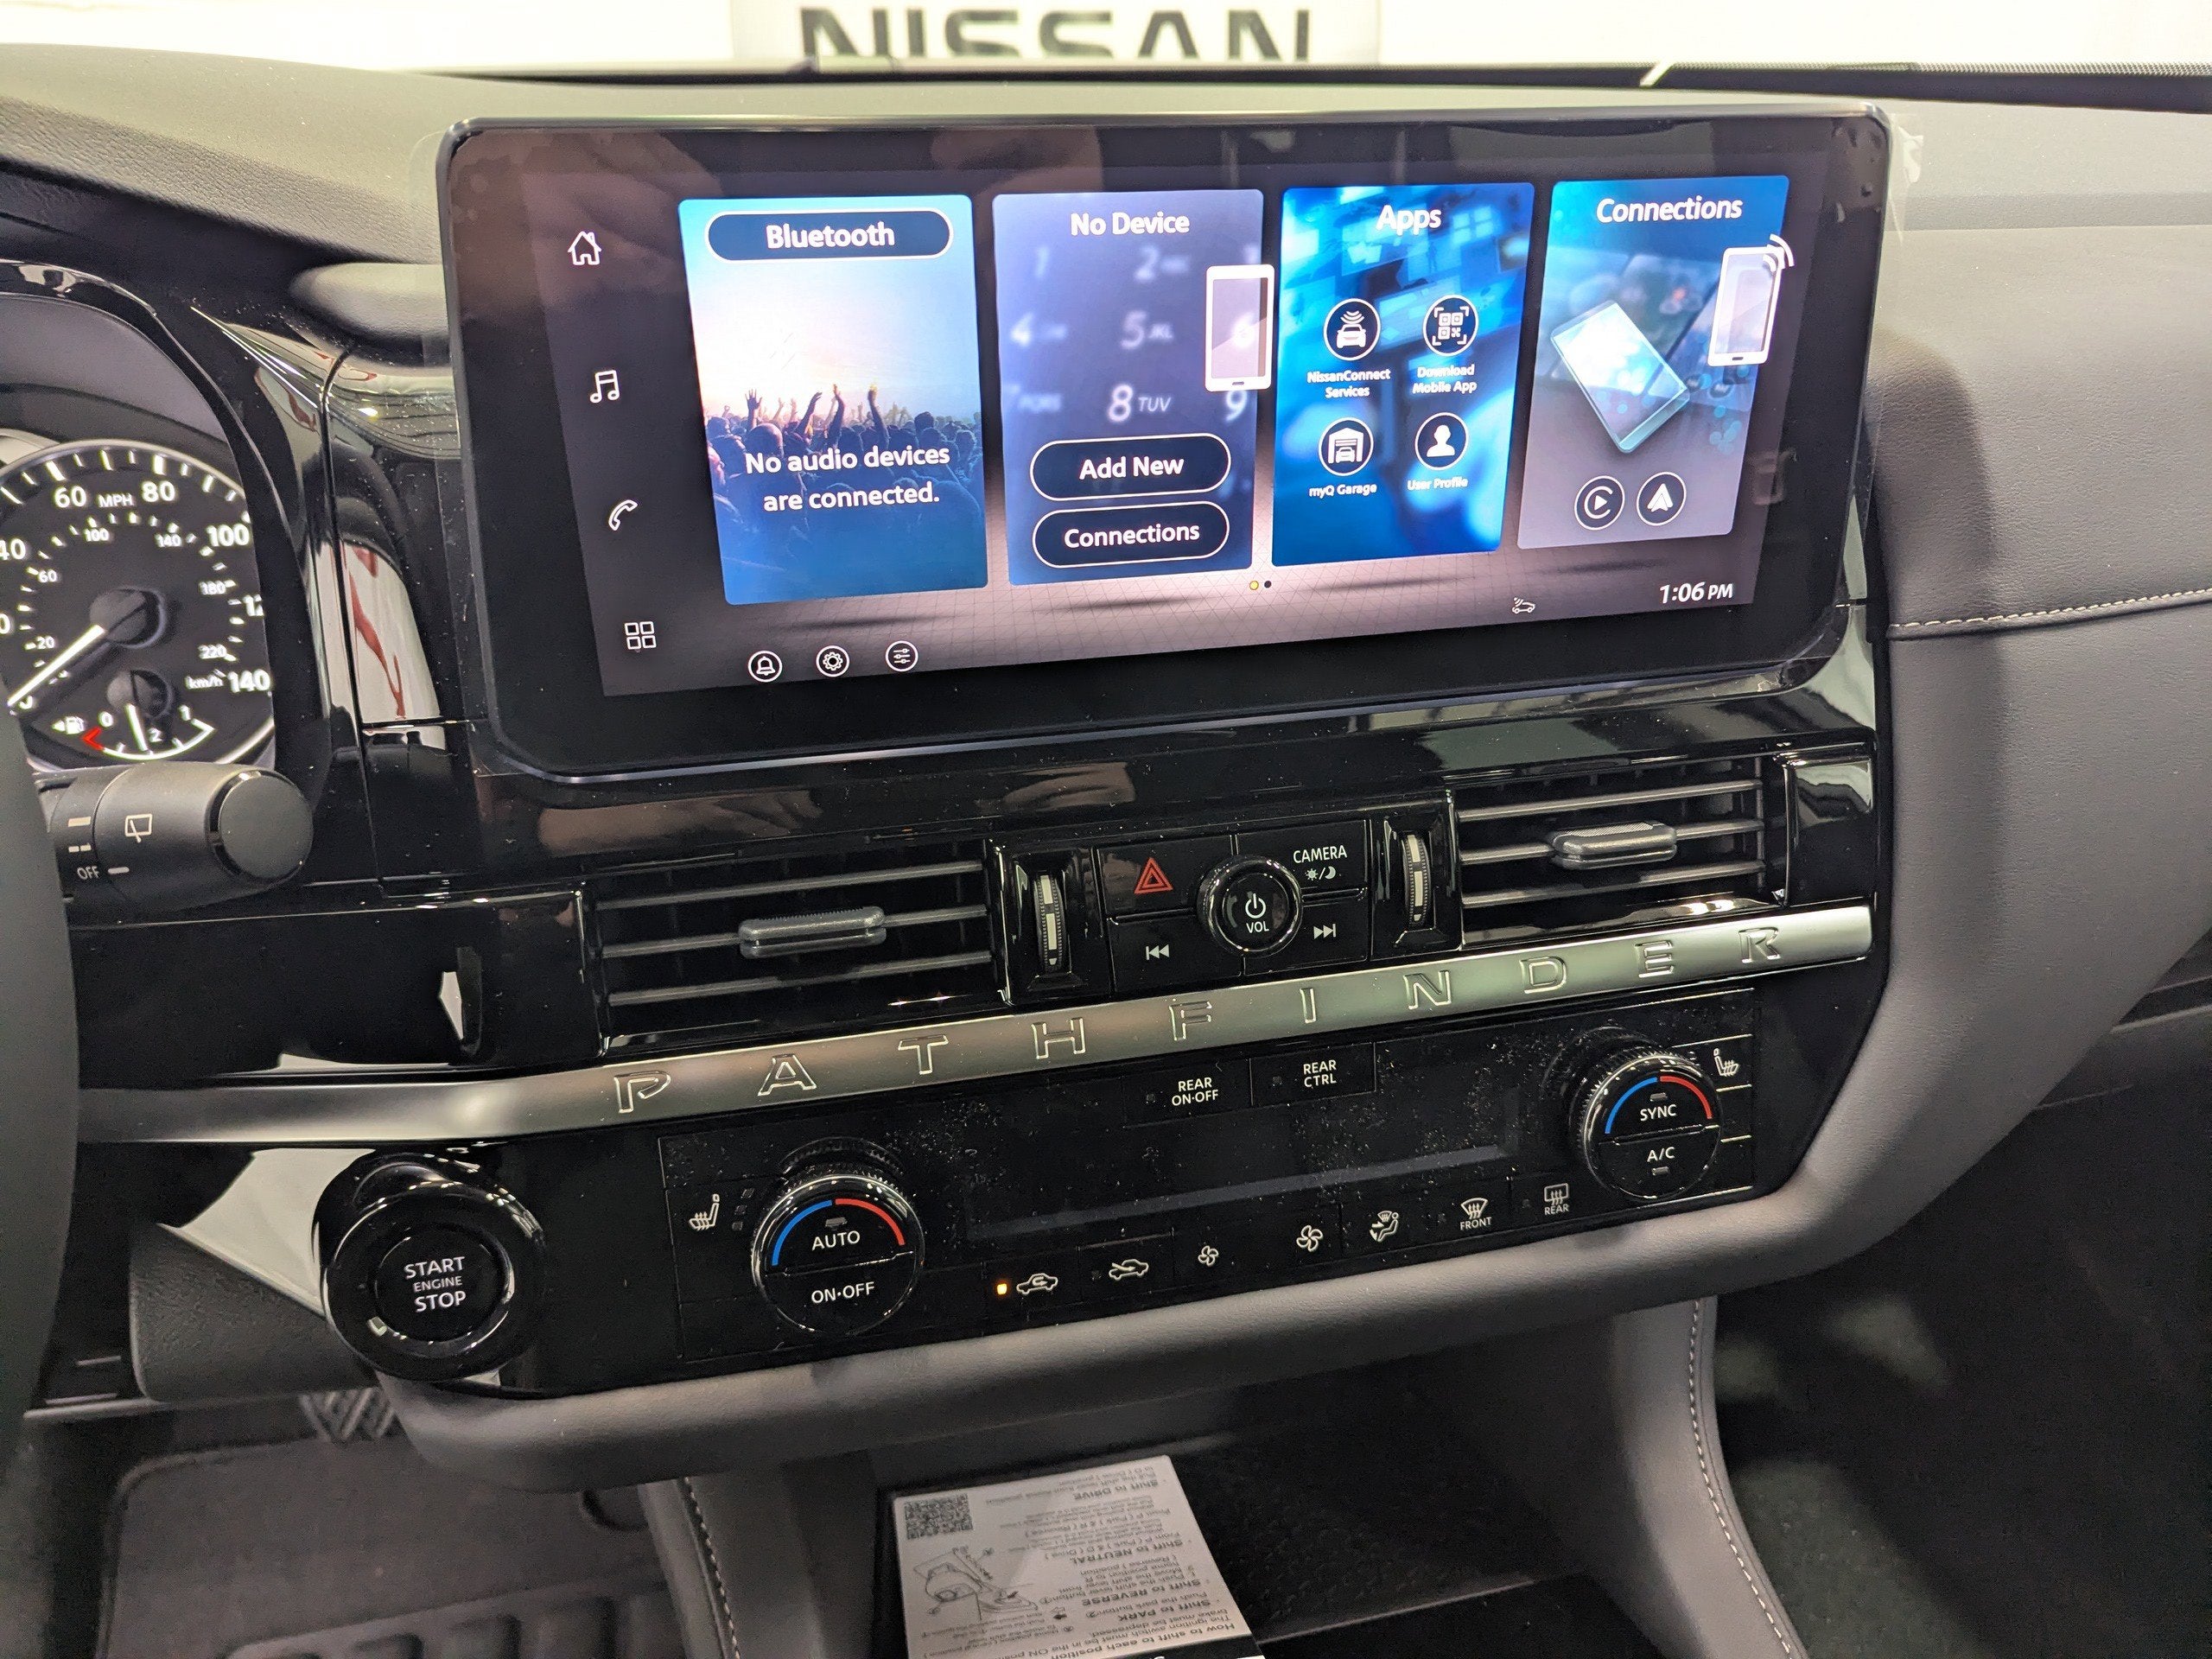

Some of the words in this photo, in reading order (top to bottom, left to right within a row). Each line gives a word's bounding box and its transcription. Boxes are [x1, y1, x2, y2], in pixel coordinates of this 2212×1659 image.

[799, 8, 1310, 60] NISSAN
[1596, 196, 1743, 225] Connections
[1070, 212, 1107, 236] No
[1111, 211, 1191, 235] Device
[1376, 204, 1442, 236] Apps
[766, 220, 896, 250] Bluetooth
[1306, 368, 1391, 384] NissanConnect
[1417, 364, 1475, 378] Download
[1325, 385, 1370, 399] Services
[1412, 383, 1452, 394] Mobile
[1452, 379, 1478, 394] App
[745, 452, 782, 474] No
[787, 447, 859, 473] audio
[864, 445, 950, 468] devices
[1079, 455, 1127, 480] Add
[1132, 456, 1185, 478] New
[141, 480, 176, 503] 80
[1309, 486, 1335, 499] myQ
[1338, 483, 1377, 497] Garage
[1407, 479, 1432, 491] User
[1433, 476, 1468, 489] Profile
[54, 485, 87, 509] 60
[97, 492, 134, 508] MPH
[763, 493, 804, 512] are
[809, 480, 940, 509] connected.
[84, 527, 111, 543] 100
[156, 532, 183, 548] 140
[207, 523, 251, 548] 100
[1064, 523, 1200, 549] Connections
[38, 569, 58, 583] 60
[199, 580, 226, 595] 180
[1660, 582, 1706, 604] 1:06
[1707, 583, 1733, 601] PM
[35, 635, 55, 650] 20
[199, 644, 227, 659] 220
[185, 671, 225, 690] km/h
[226, 668, 271, 693] 140
[1293, 844, 1348, 863] CAMERA
[76, 865, 99, 880] OFF
[1246, 920, 1269, 934] VOL
[612, 927, 1783, 1114] PATHFINDER
[1303, 1058, 1338, 1075] REAR
[1177, 1077, 1213, 1093] REAR
[1303, 1071, 1338, 1088] CTRL
[1640, 1103, 1678, 1122] SYNC
[1647, 1146, 1676, 1162] A/C
[1544, 1202, 1570, 1216] REAR
[1459, 1217, 1492, 1230] FRONT
[810, 1228, 861, 1252] AUTO
[403, 1255, 467, 1280] START
[412, 1274, 463, 1293] ENGINE
[415, 1290, 467, 1313] STOP
[1082, 1589, 1147, 1606] REVERSE
[1179, 1599, 1211, 1610] Shift
[1117, 1609, 1156, 1622] PARK
[1158, 1631, 1185, 1641] shift
[1206, 1623, 1235, 1633] How
